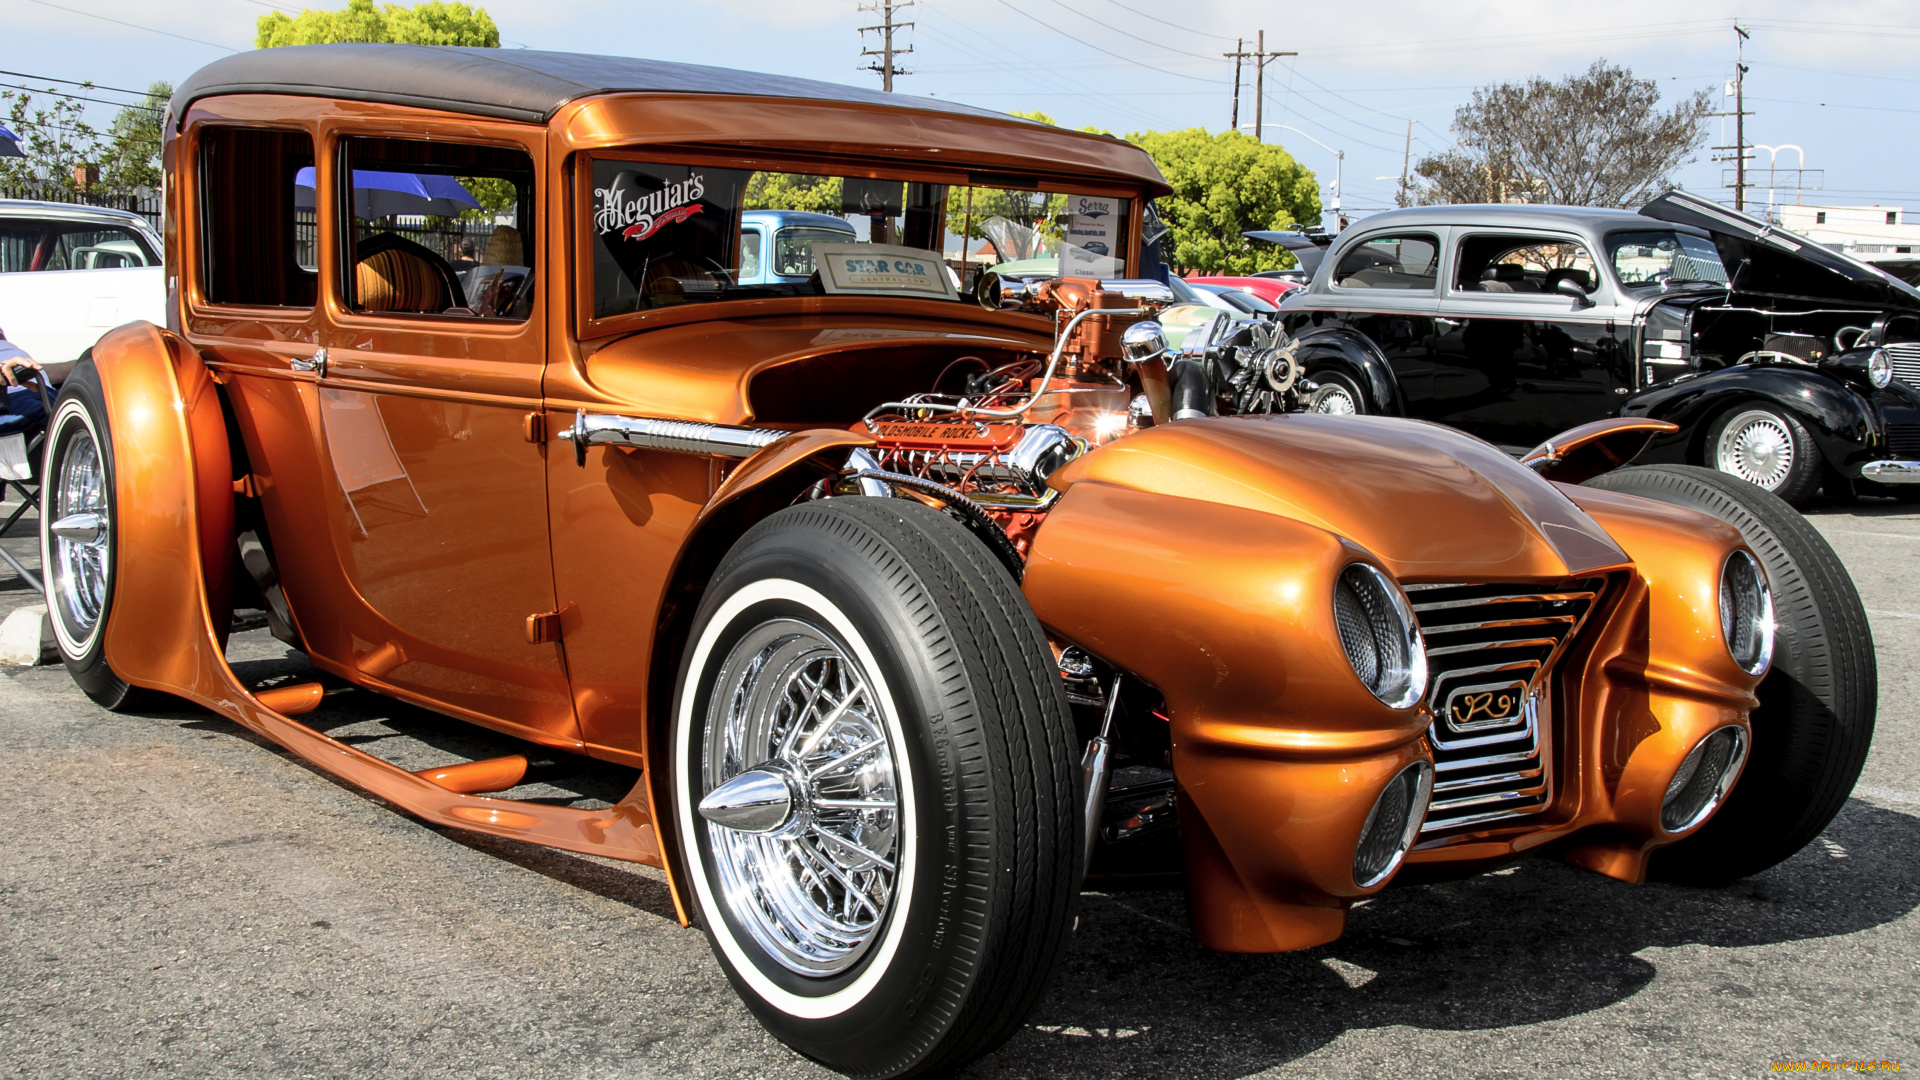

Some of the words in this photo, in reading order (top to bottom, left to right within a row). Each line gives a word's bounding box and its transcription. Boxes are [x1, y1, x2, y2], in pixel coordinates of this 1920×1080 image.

[594, 172, 704, 237] Meguiar's
[1079, 198, 1110, 215] Serra
[845, 259, 890, 274] STAR
[894, 260, 927, 276] CAR
[877, 425, 939, 438] OLDSMOBILE
